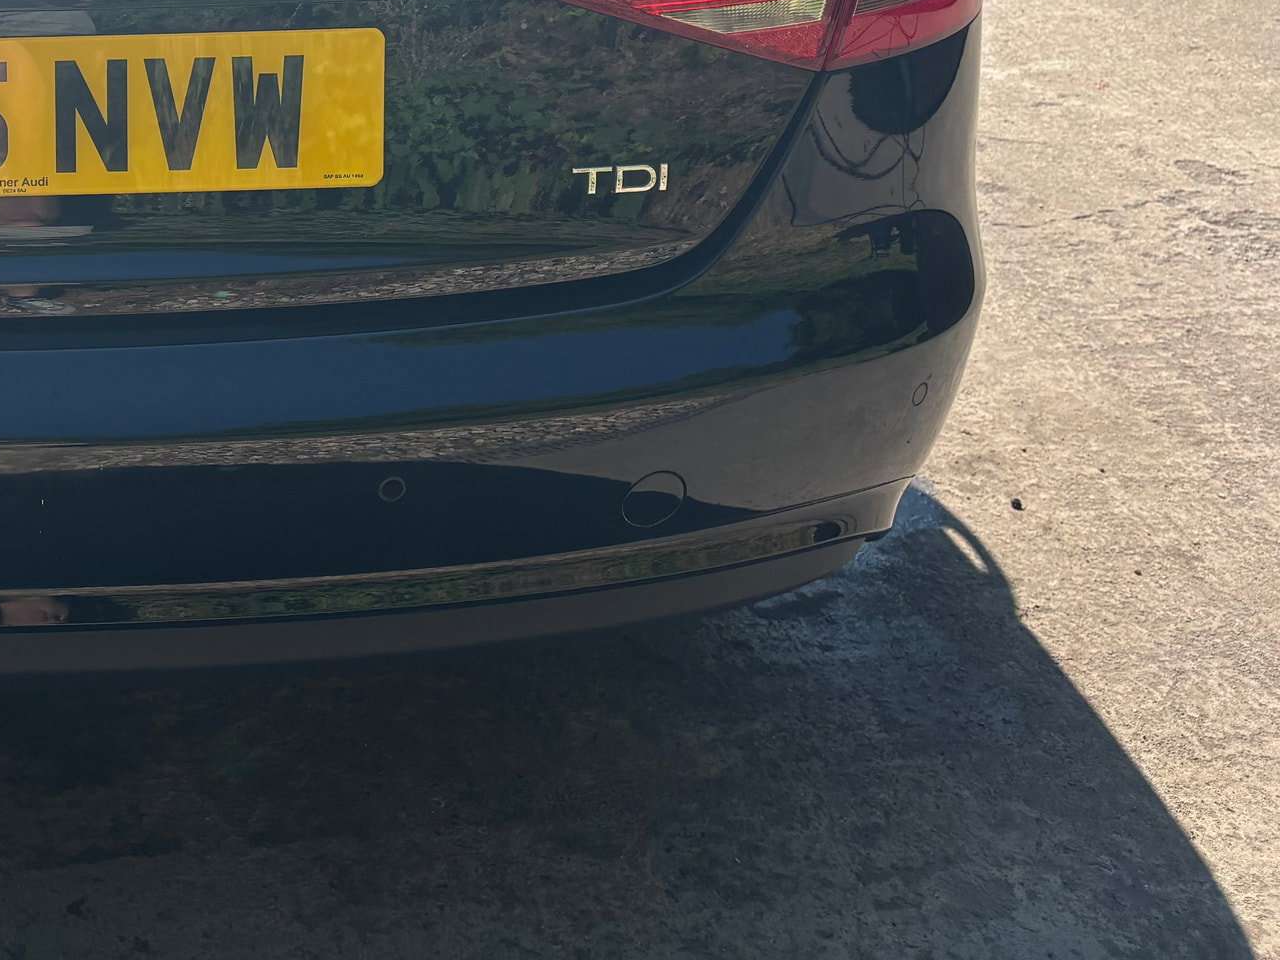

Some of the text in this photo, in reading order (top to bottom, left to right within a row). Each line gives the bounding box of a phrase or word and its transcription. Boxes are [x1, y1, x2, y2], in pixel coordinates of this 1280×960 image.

[56, 55, 305, 174] NVW
[21, 176, 49, 187] Audi
[572, 163, 669, 195] TDI
